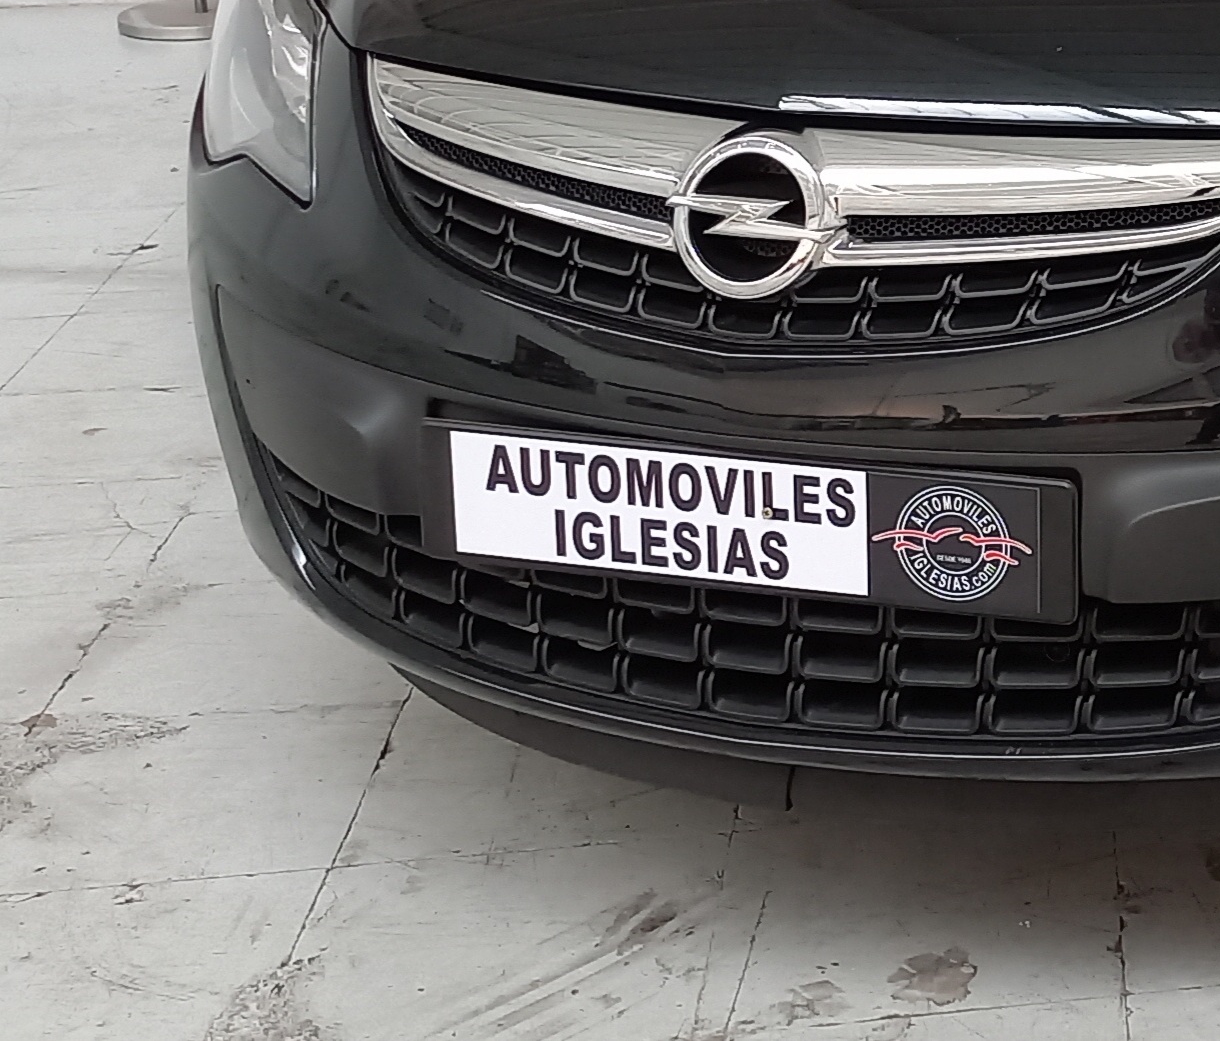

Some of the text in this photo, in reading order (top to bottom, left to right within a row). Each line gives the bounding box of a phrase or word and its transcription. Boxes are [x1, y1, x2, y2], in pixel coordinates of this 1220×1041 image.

[485, 444, 856, 528] AUTOMOVILES
[911, 495, 996, 534] AUTOMOVILES
[554, 509, 790, 581] IGLESIAS
[909, 553, 997, 592] IGLESIAS.com
